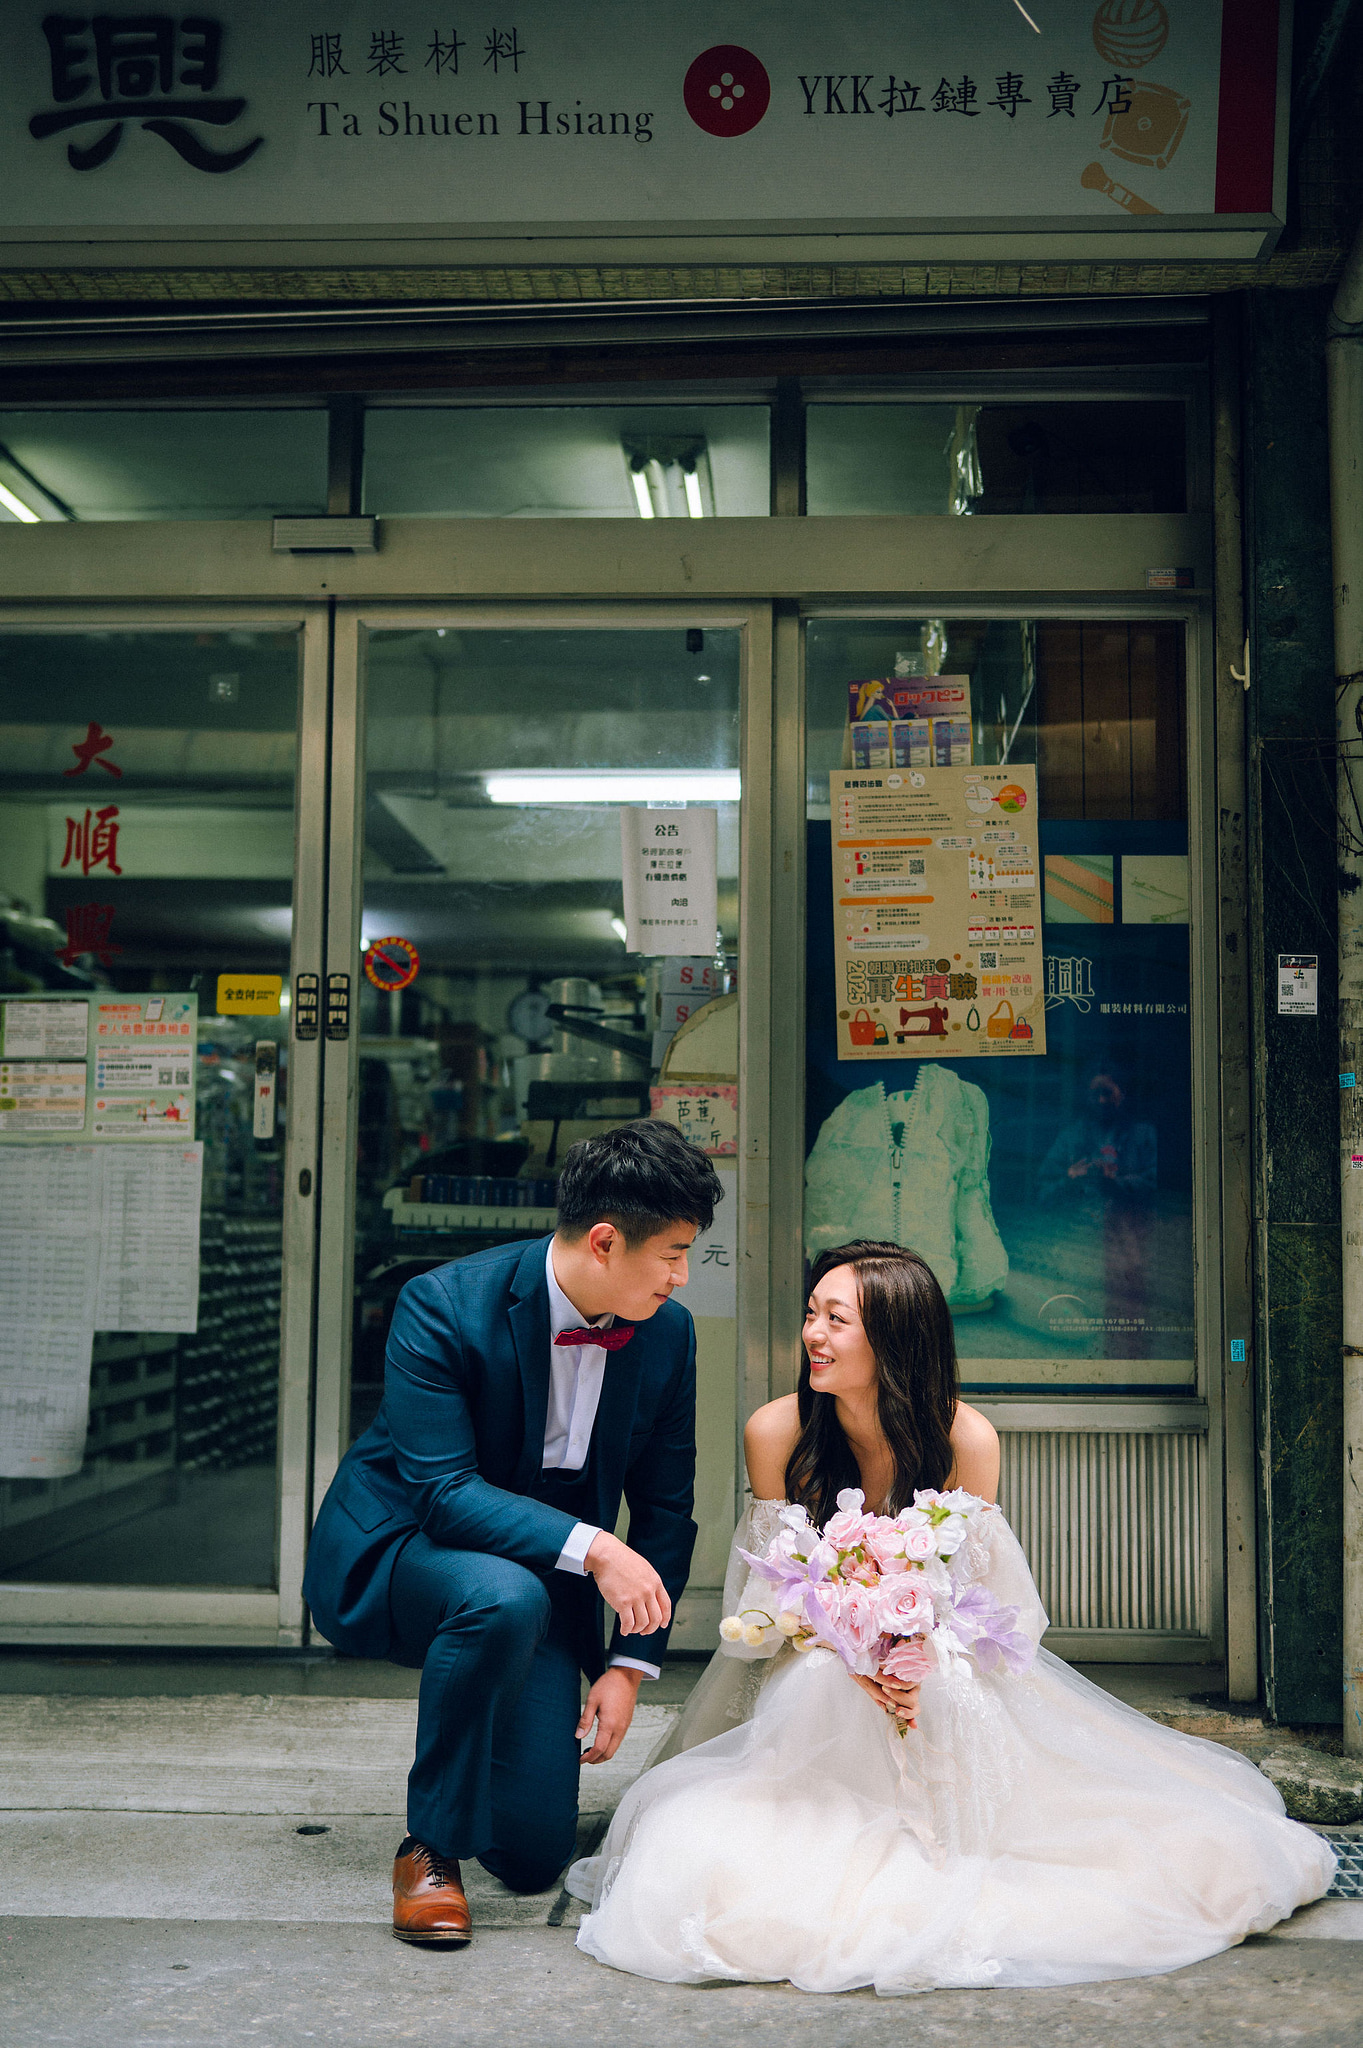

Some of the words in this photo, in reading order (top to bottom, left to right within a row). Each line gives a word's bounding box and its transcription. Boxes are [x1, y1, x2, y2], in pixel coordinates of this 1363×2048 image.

[307, 26, 527, 78] 服裝材料
[28, 14, 265, 174] 興
[307, 101, 363, 137] Ta
[378, 100, 500, 137] Shuen
[516, 100, 655, 143] Hsiang
[56, 721, 124, 967] 大順興
[654, 824, 679, 837] 公告
[846, 960, 867, 1005] 2025
[866, 972, 978, 1004] 再生實驗
[1099, 1002, 1187, 1014] 服裝材料有限公司
[701, 1244, 730, 1267] 元
